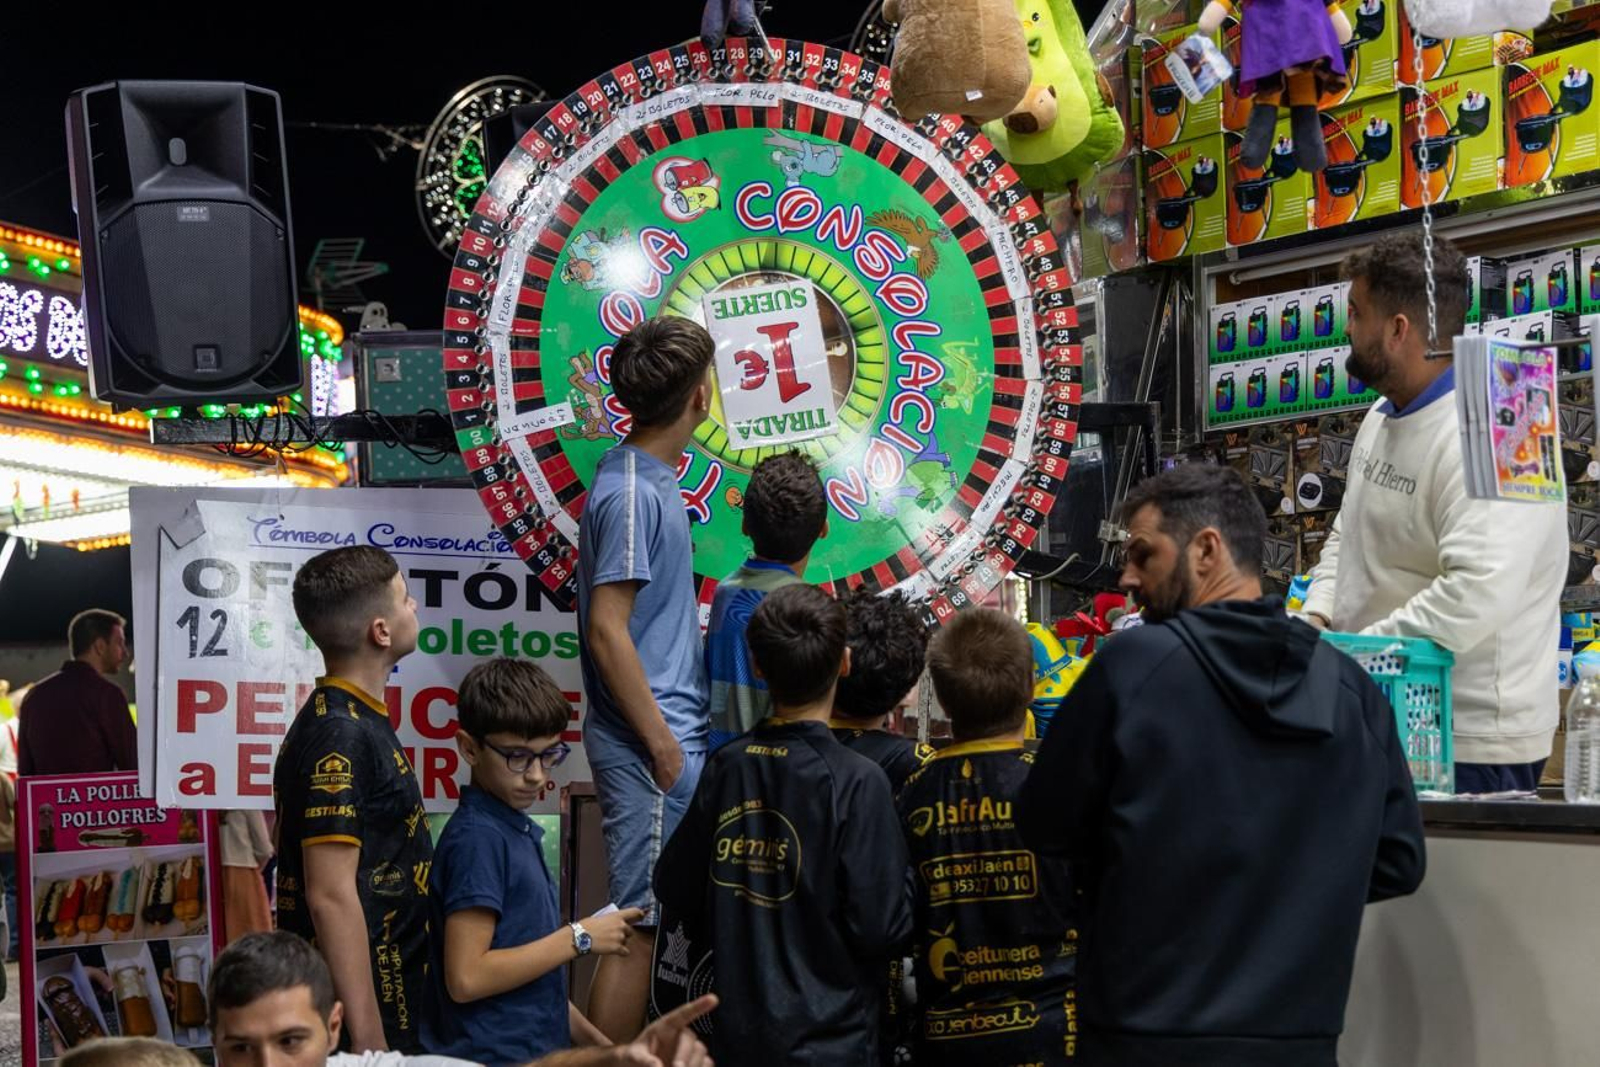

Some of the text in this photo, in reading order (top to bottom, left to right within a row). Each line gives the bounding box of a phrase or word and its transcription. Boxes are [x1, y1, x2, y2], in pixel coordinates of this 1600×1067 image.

[692, 50, 708, 63] 26
[712, 48, 726, 60] 27
[731, 48, 744, 60] 28
[750, 48, 764, 59] 29
[787, 50, 800, 61] 31
[806, 53, 820, 65] 32
[655, 60, 672, 74] 24
[674, 54, 690, 68] 25
[825, 58, 838, 71] 33
[638, 65, 654, 80] 23
[842, 63, 856, 76] 34
[860, 70, 874, 83] 35
[620, 72, 637, 87] 22
[877, 76, 890, 90] 36
[604, 82, 619, 97] 21
[1441, 81, 1459, 98] MAX
[588, 90, 602, 106] 20
[573, 101, 588, 116] 19
[557, 112, 573, 128] 18
[942, 119, 955, 132] 40
[544, 126, 560, 141] 17
[956, 131, 969, 144] 41
[531, 138, 546, 154] 16
[968, 143, 984, 157] 42
[982, 159, 996, 173] 43
[994, 173, 1008, 187] 44
[1006, 190, 1019, 204] 45
[487, 202, 500, 216] 12
[1016, 206, 1029, 220] 46
[480, 220, 492, 234] 11
[1025, 222, 1038, 236] 47
[473, 238, 486, 252] 10
[1034, 240, 1046, 253] 48
[467, 258, 480, 268] 9
[1040, 257, 1052, 270] 49
[463, 278, 474, 286] 8
[1046, 275, 1058, 288] 50
[460, 297, 471, 306] 7
[711, 287, 808, 320] SUERTE
[1051, 293, 1064, 306] 51
[458, 316, 470, 324] 6
[1055, 311, 1066, 326] 52
[457, 336, 468, 344] 5
[1058, 330, 1069, 344] 53
[457, 355, 468, 363] 4
[1060, 348, 1070, 362] 54
[1060, 367, 1070, 382] 55
[462, 394, 474, 402] 2
[1060, 386, 1070, 400] 56
[466, 414, 477, 422] 1
[1058, 404, 1068, 418] 57
[735, 408, 831, 440] TIRADA
[1054, 422, 1066, 436] 58
[470, 430, 484, 445] 00
[1050, 440, 1062, 454] 59
[476, 448, 490, 464] 99
[1044, 458, 1057, 472] 60
[484, 466, 498, 482] 98
[1374, 462, 1417, 495] Hierro
[1038, 474, 1050, 489] 61
[492, 486, 507, 500] 97
[1030, 492, 1044, 506] 62
[502, 502, 516, 518] 96
[1022, 508, 1035, 523] 63
[512, 519, 528, 534] 95
[1012, 524, 1026, 539] 64
[524, 534, 540, 550] 94
[1002, 539, 1016, 554] 65
[538, 550, 552, 566] 93
[990, 554, 1004, 568] 66
[551, 563, 567, 579] 92
[182, 557, 576, 612] OFTÓN
[966, 580, 979, 594] 68
[952, 592, 966, 606] 69
[938, 603, 952, 616] 70
[922, 614, 937, 626] 71
[176, 605, 229, 658] 12
[417, 618, 578, 658] oletos
[179, 762, 217, 796] a
[57, 786, 81, 803] LA
[61, 806, 168, 828] POLLOFRES
[1013, 874, 1030, 890] 10
[376, 945, 389, 965] DE
